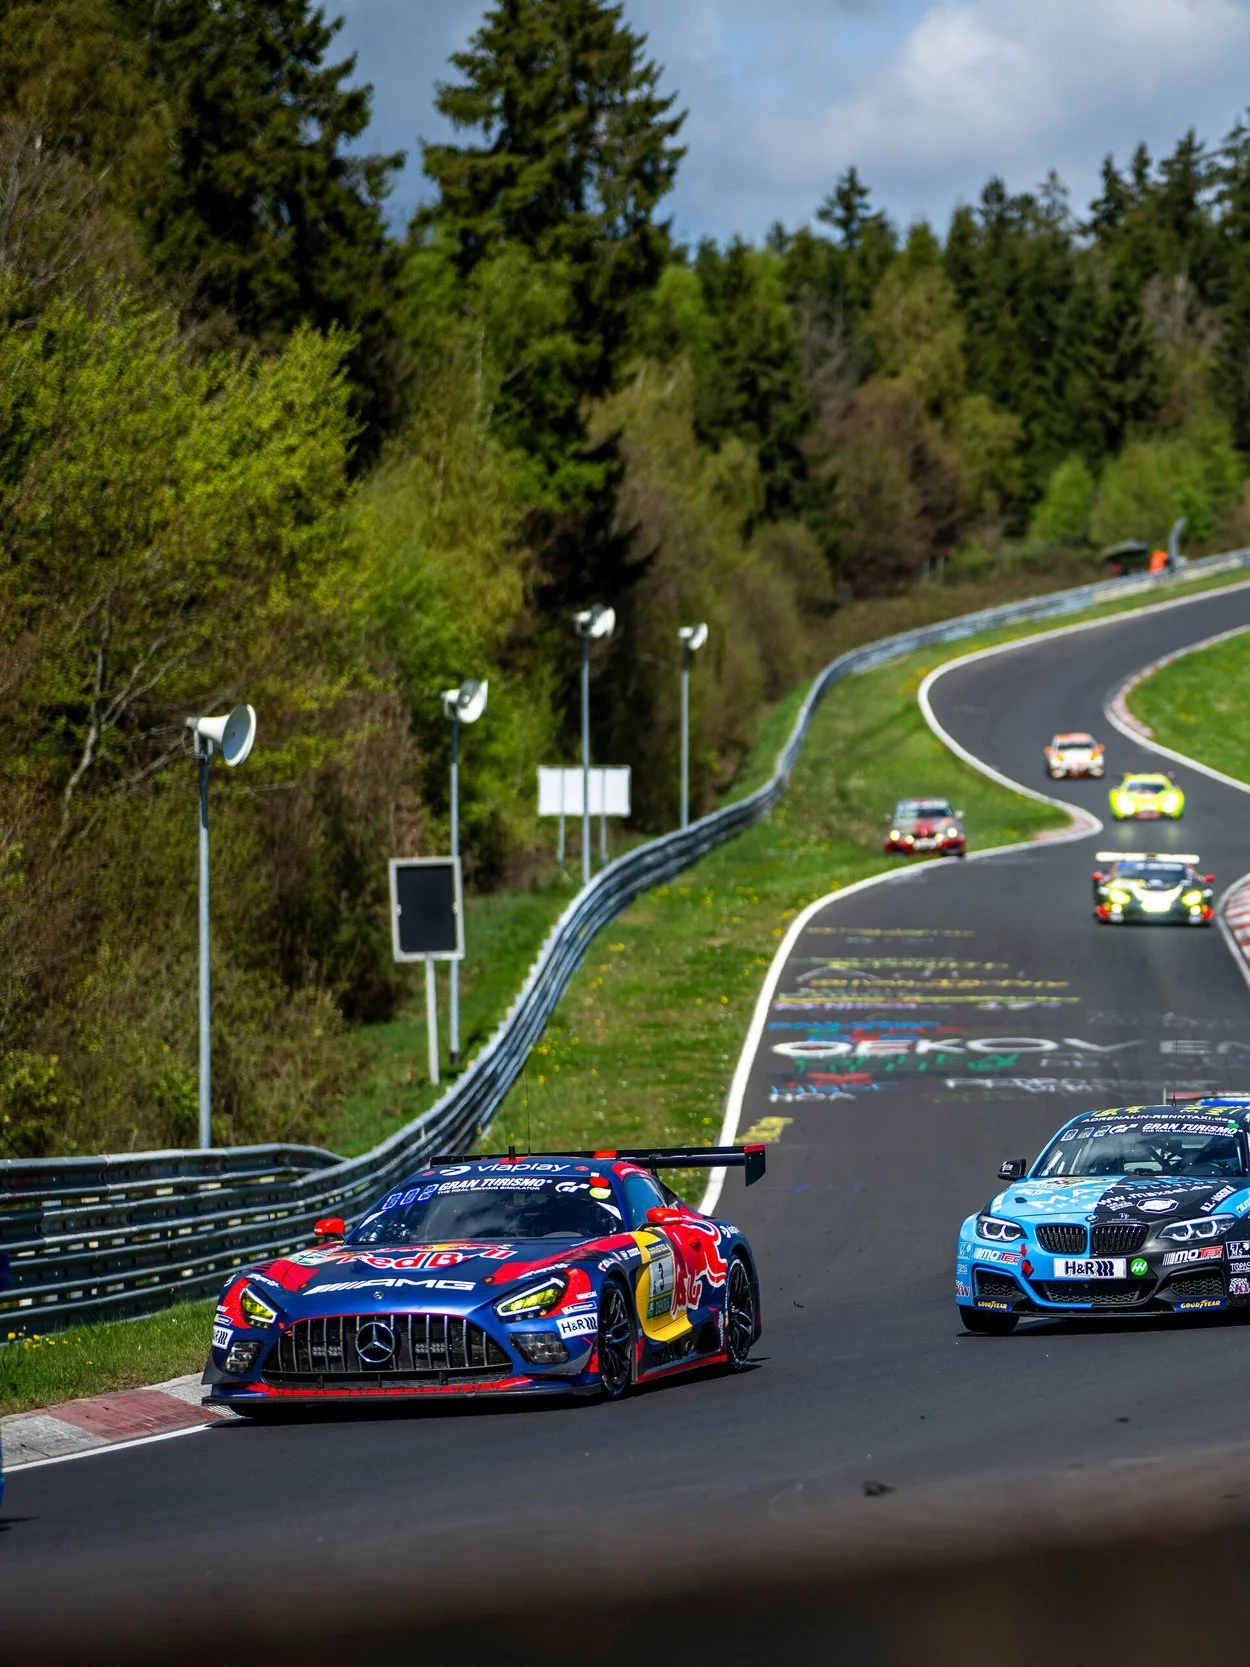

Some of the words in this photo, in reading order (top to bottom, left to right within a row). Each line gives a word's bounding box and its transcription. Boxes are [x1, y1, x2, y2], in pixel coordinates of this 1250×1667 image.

[1142, 1122, 1181, 1131] GRAN
[1182, 1123, 1238, 1135] TURISMO
[477, 1163, 571, 1173] viaplay
[438, 1179, 477, 1191] GRAN
[482, 1178, 547, 1188] TURISMO
[336, 1251, 427, 1270] Red
[1064, 1261, 1095, 1276] H&R
[1180, 1299, 1221, 1309] GOODYEAR
[561, 1319, 585, 1334] H&R
